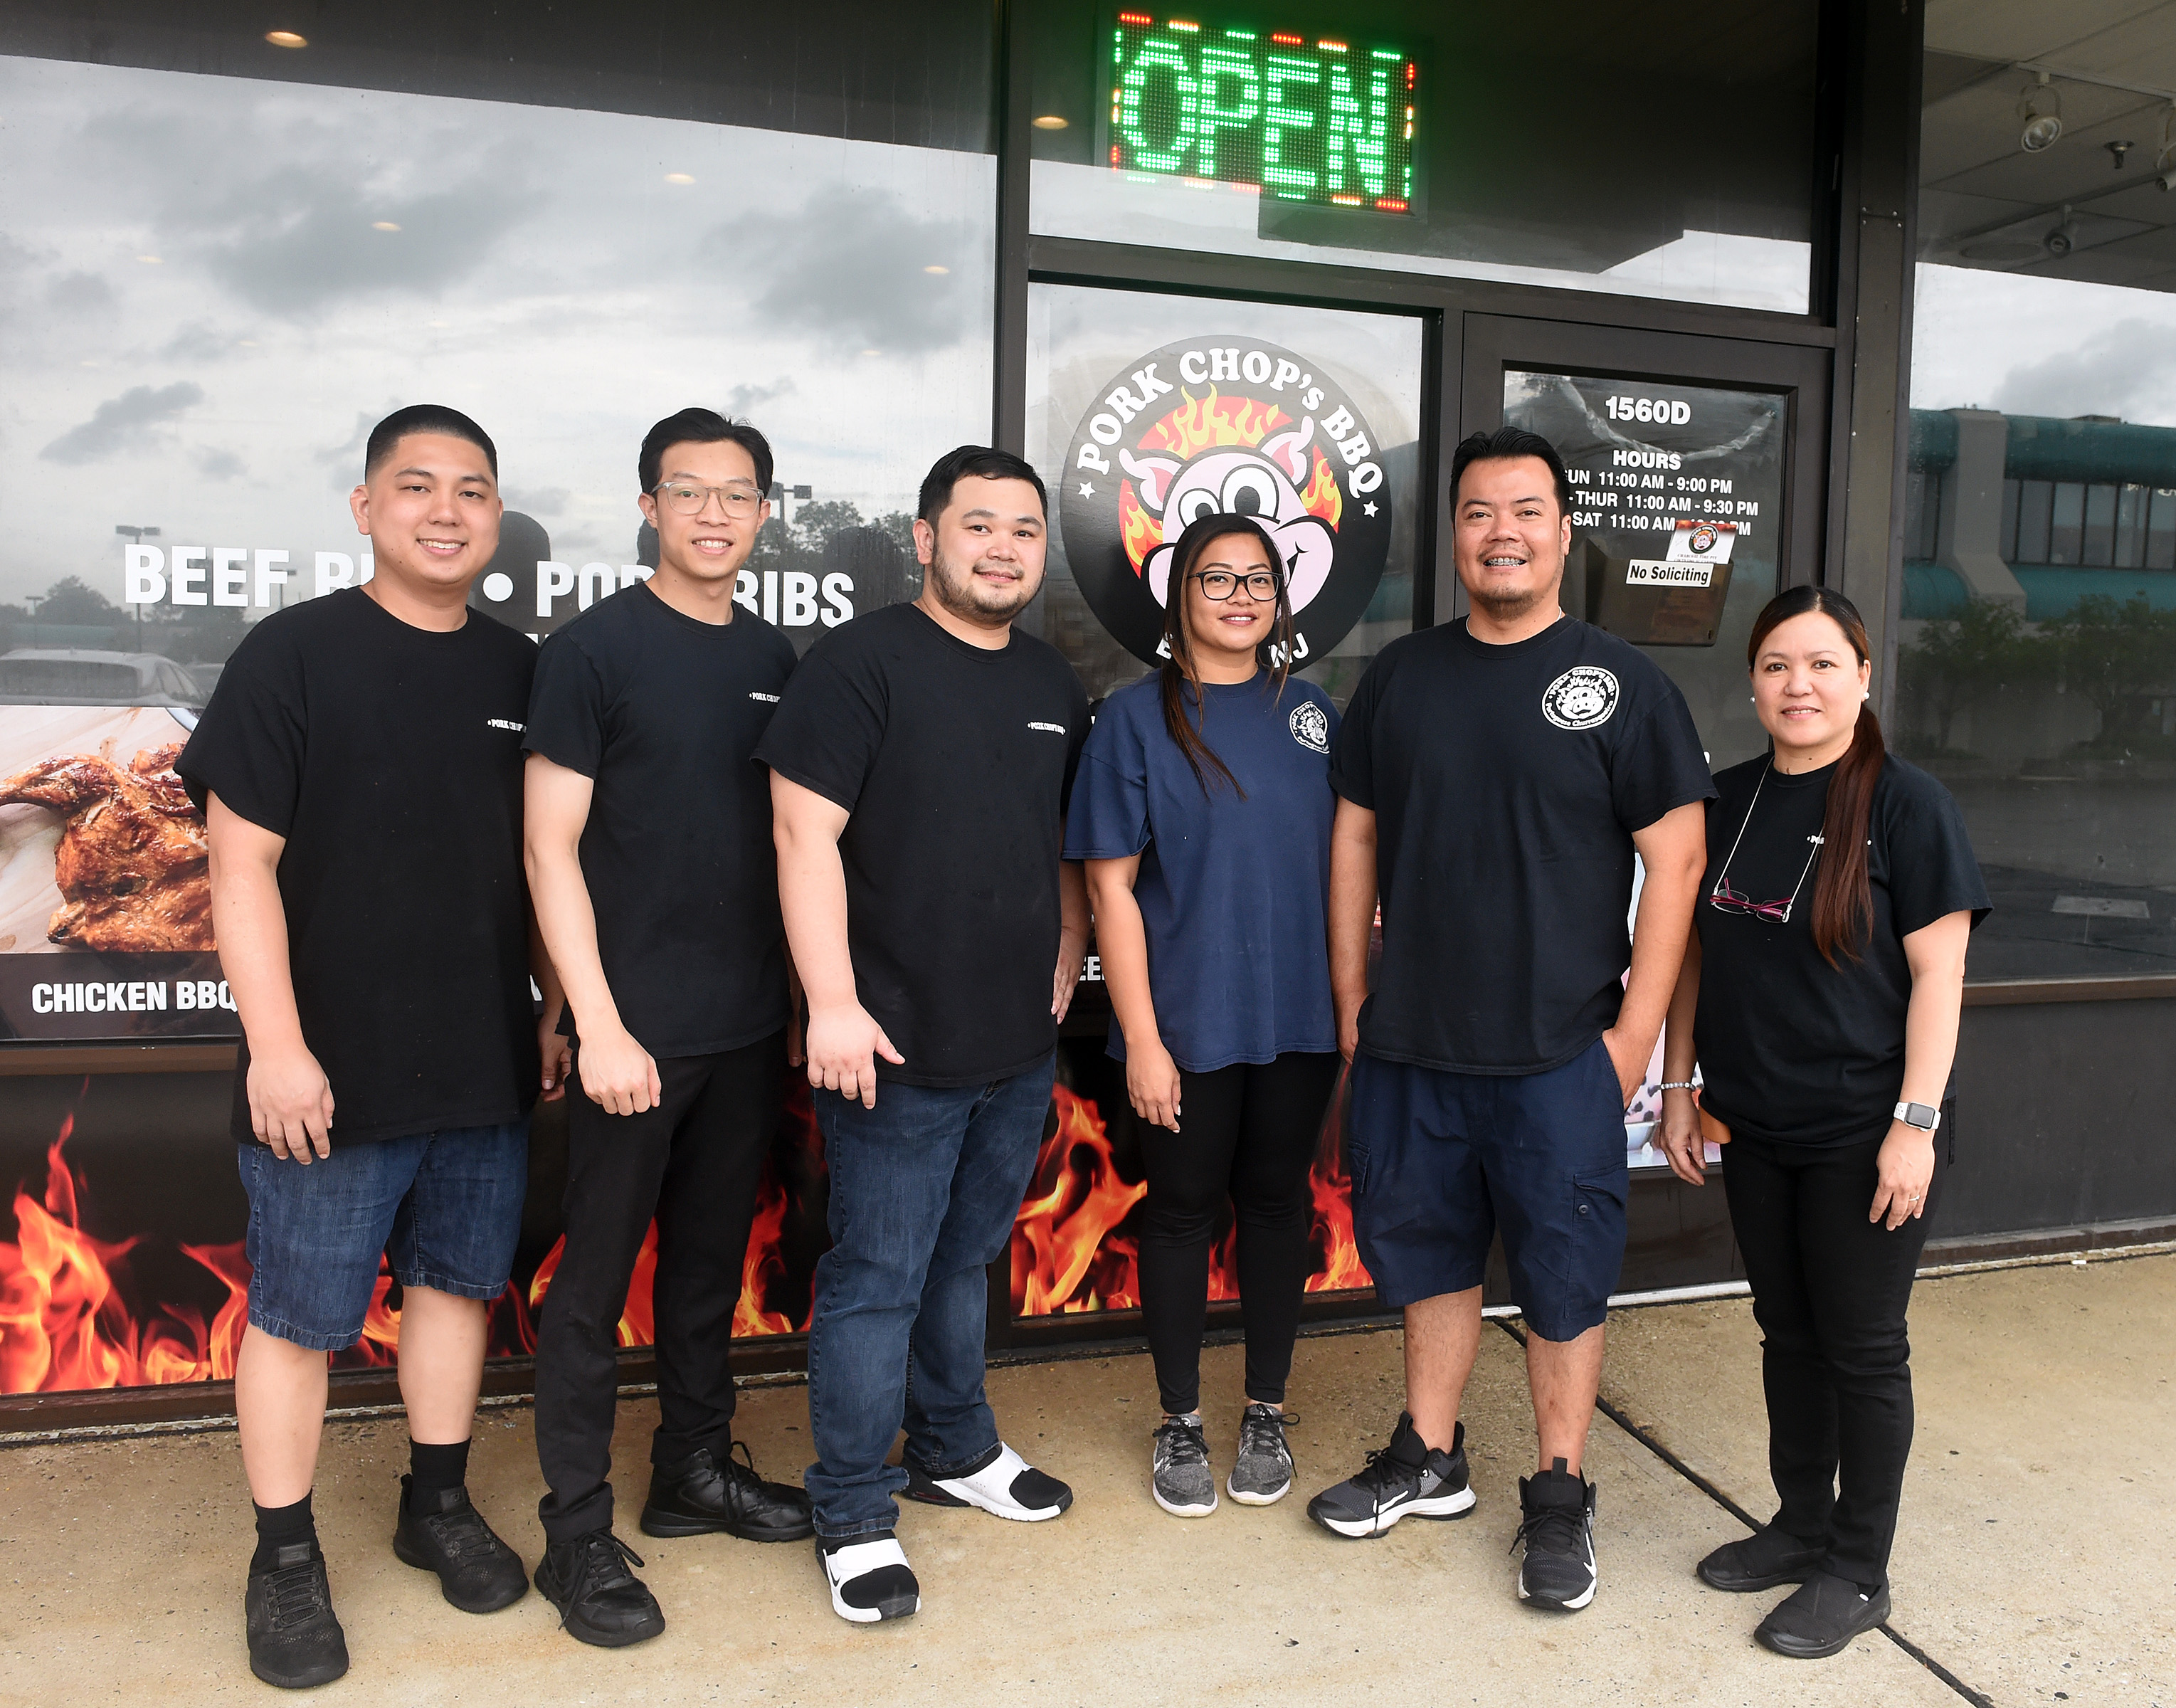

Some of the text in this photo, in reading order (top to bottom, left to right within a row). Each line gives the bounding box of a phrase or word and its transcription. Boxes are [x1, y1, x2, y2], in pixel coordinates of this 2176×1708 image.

[1122, 40, 1386, 194] OPEN
[1605, 396, 1691, 425] 1560D
[1077, 348, 1383, 499] PORK CHOP'S BBQ
[1612, 450, 1681, 470] HOURS
[1565, 469, 1590, 485] UN
[1598, 471, 1637, 487] 11:00
[1640, 474, 1664, 490] AM
[1676, 476, 1707, 492] 9:00
[1710, 478, 1733, 494] PM
[1575, 490, 1618, 507] THUR
[1626, 494, 1665, 510] 11:00
[1667, 497, 1691, 512] AM
[1703, 499, 1733, 515] 9:30
[1736, 500, 1759, 516] PM
[1572, 511, 1602, 527] SAT
[1610, 514, 1649, 530] 11:00
[1652, 516, 1676, 531] AM
[125, 544, 290, 608] BEEF
[315, 551, 375, 598] RI
[732, 569, 854, 628] RIBS
[1630, 565, 1709, 585] No Soliciting
[1268, 632, 1316, 668] NJ
[752, 692, 767, 701] PORK
[1549, 675, 1571, 695] PORK
[491, 719, 509, 729] PORK
[32, 980, 238, 1013] CHICKEN BBQ
